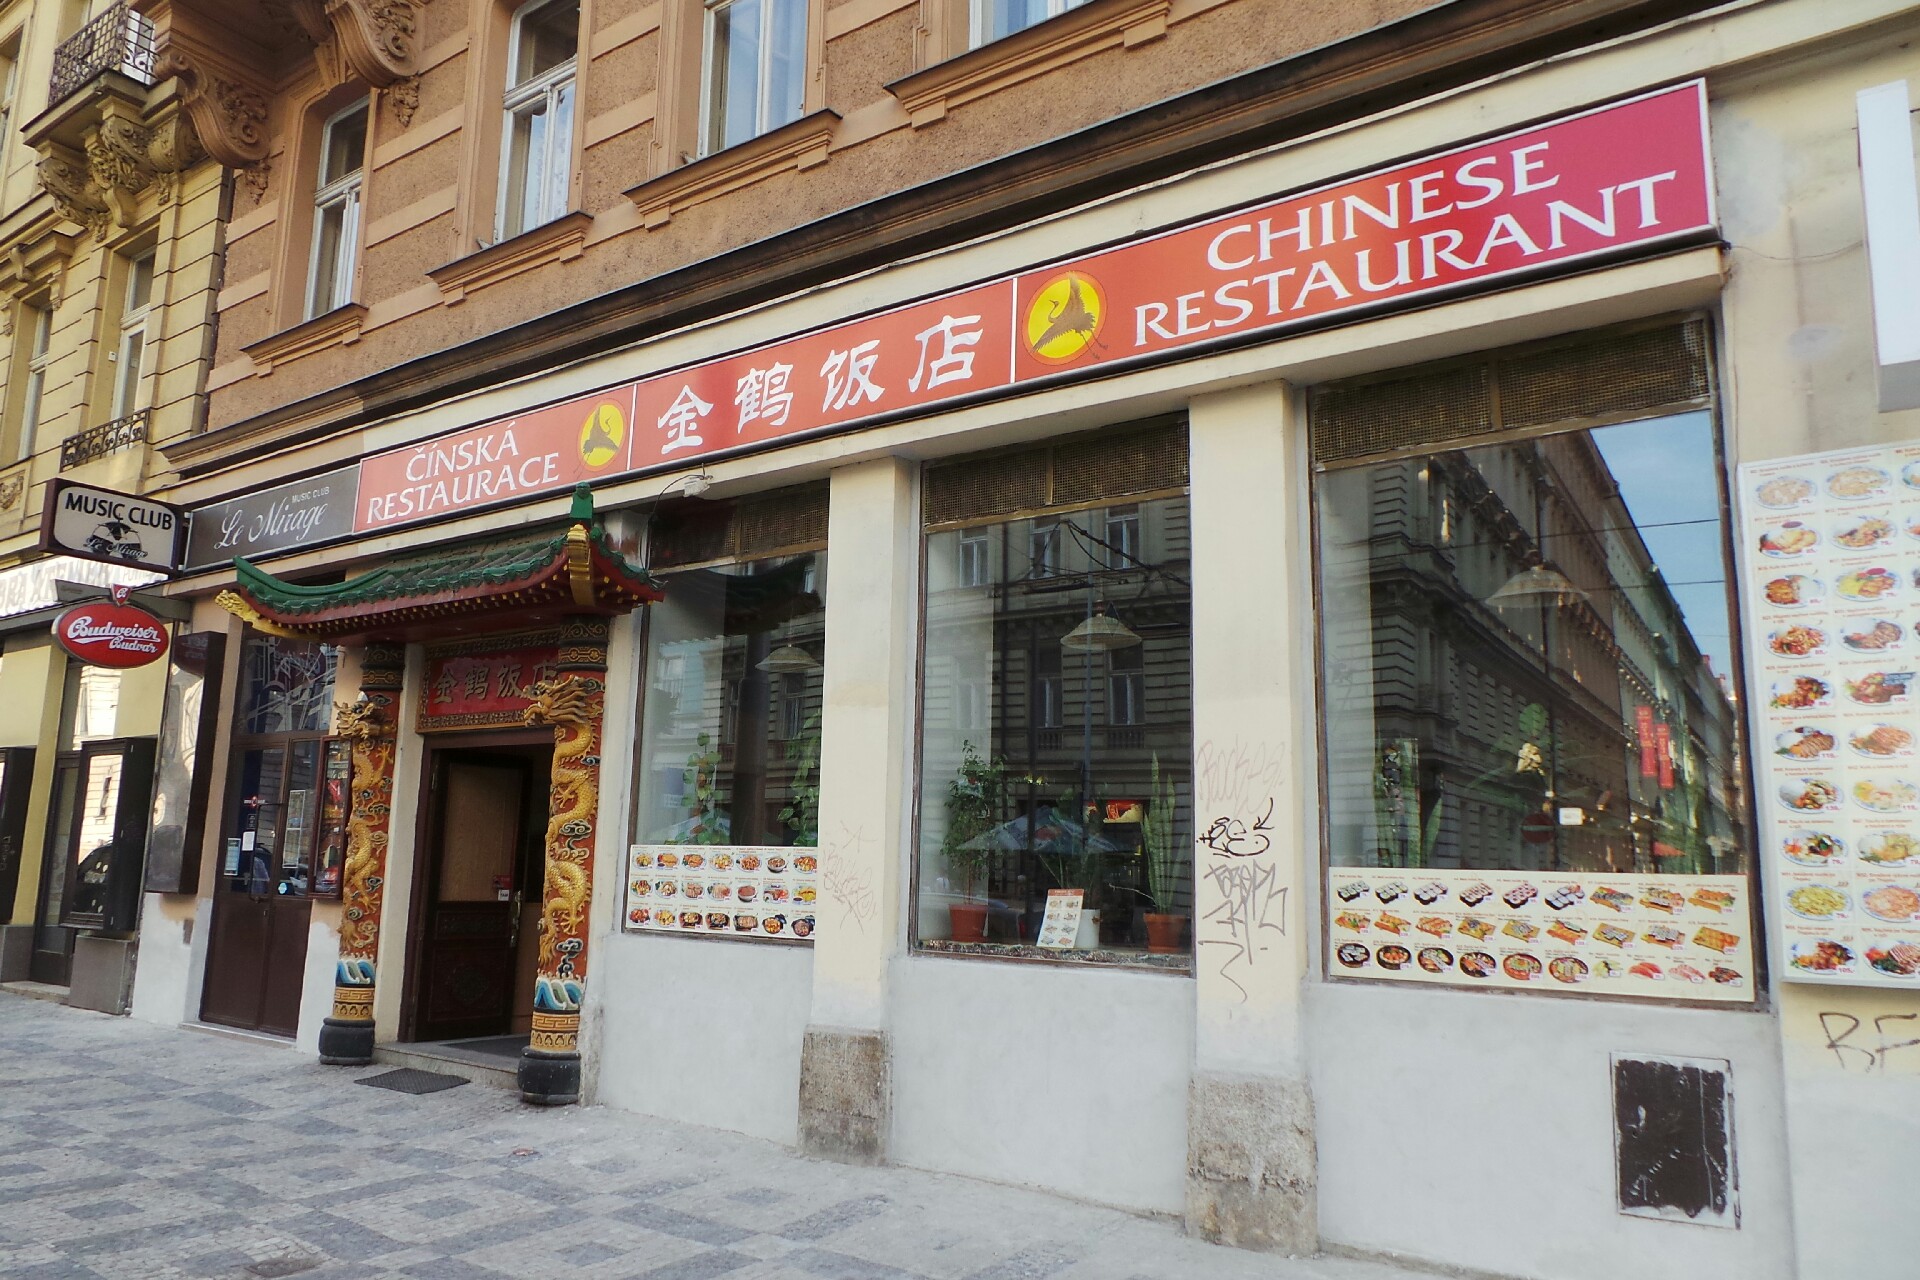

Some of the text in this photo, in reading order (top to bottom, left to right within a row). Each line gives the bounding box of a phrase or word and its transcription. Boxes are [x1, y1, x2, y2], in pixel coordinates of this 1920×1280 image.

[1207, 142, 1559, 273] CHINESE
[1134, 169, 1677, 346] RESTAURANT
[657, 315, 983, 454] 金鹤饭店
[406, 422, 518, 482] ČÍNSKÁ
[65, 492, 173, 531] MUSIC CLUB
[291, 486, 330, 503] MUSIC CLUB
[367, 452, 559, 523] RESTAURACE
[214, 496, 328, 550] Le Mirage
[67, 616, 160, 641] Budweiser
[109, 636, 158, 653] Budvar
